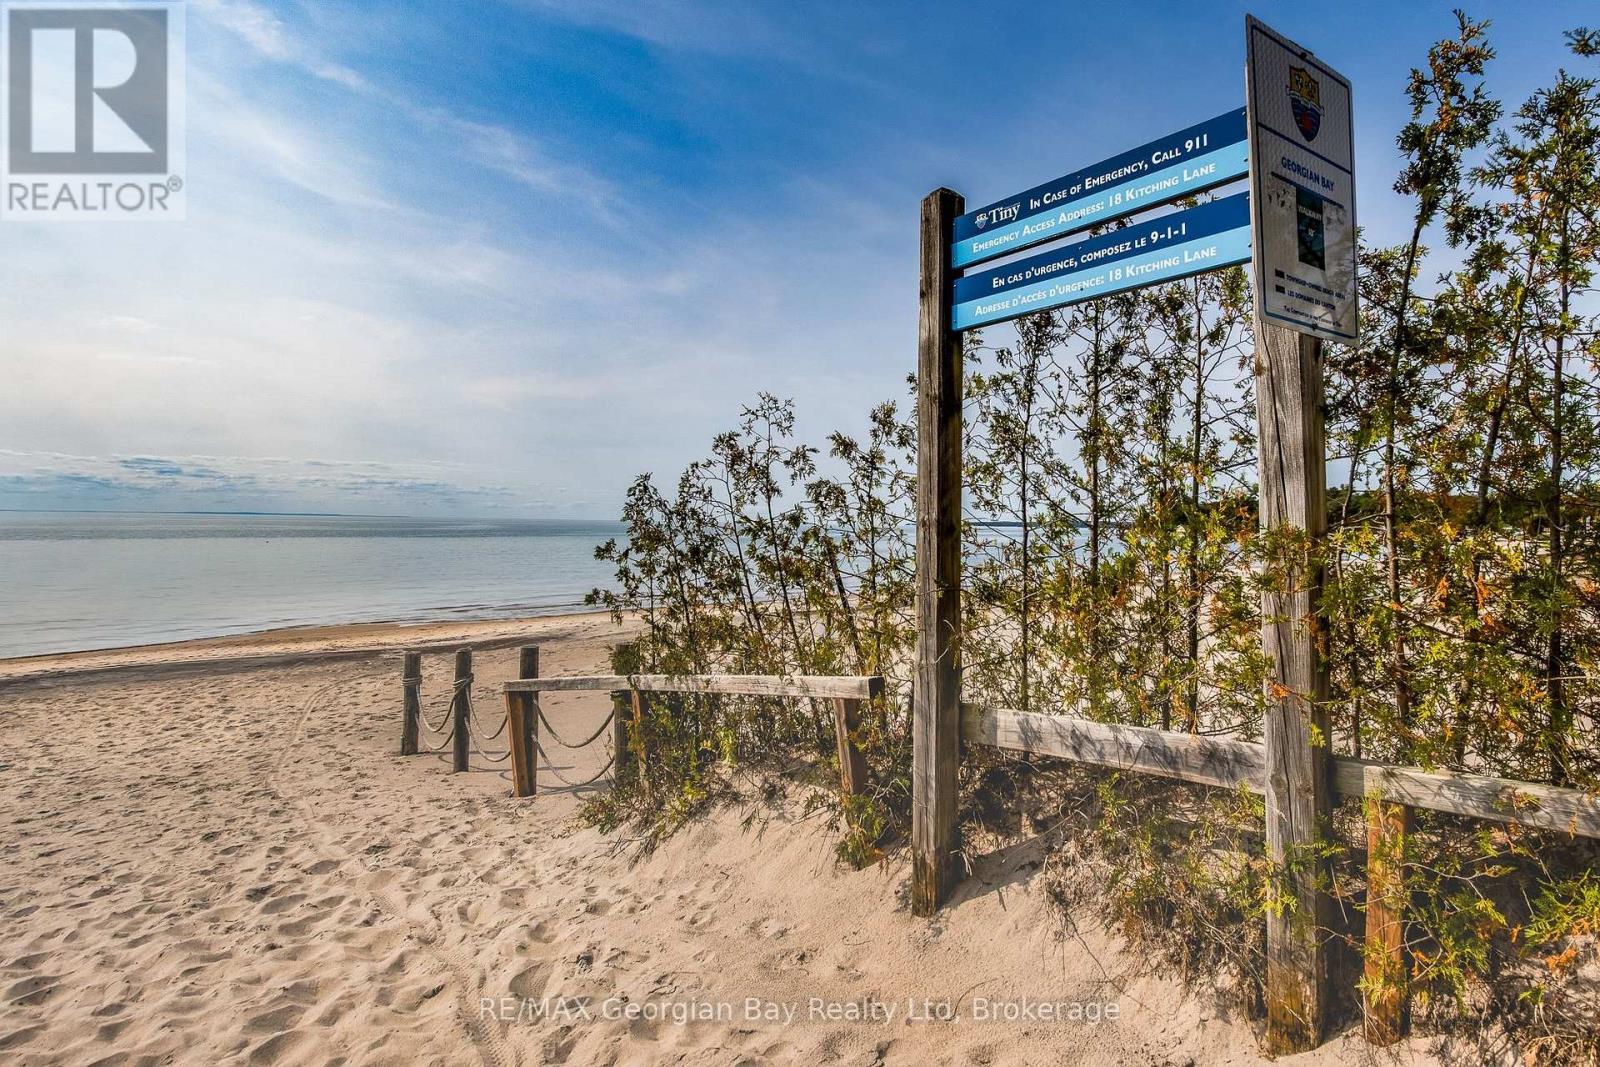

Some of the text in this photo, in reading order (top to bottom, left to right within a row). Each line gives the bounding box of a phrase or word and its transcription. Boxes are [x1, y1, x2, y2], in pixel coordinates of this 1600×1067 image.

[1185, 133, 1208, 152] 911
[1281, 156, 1335, 192] GEORGIAN BAY
[1109, 193, 1122, 207] 18
[989, 202, 1020, 224] Tiny
[1150, 222, 1186, 243] 9-1-1
[1109, 269, 1123, 282] 18
